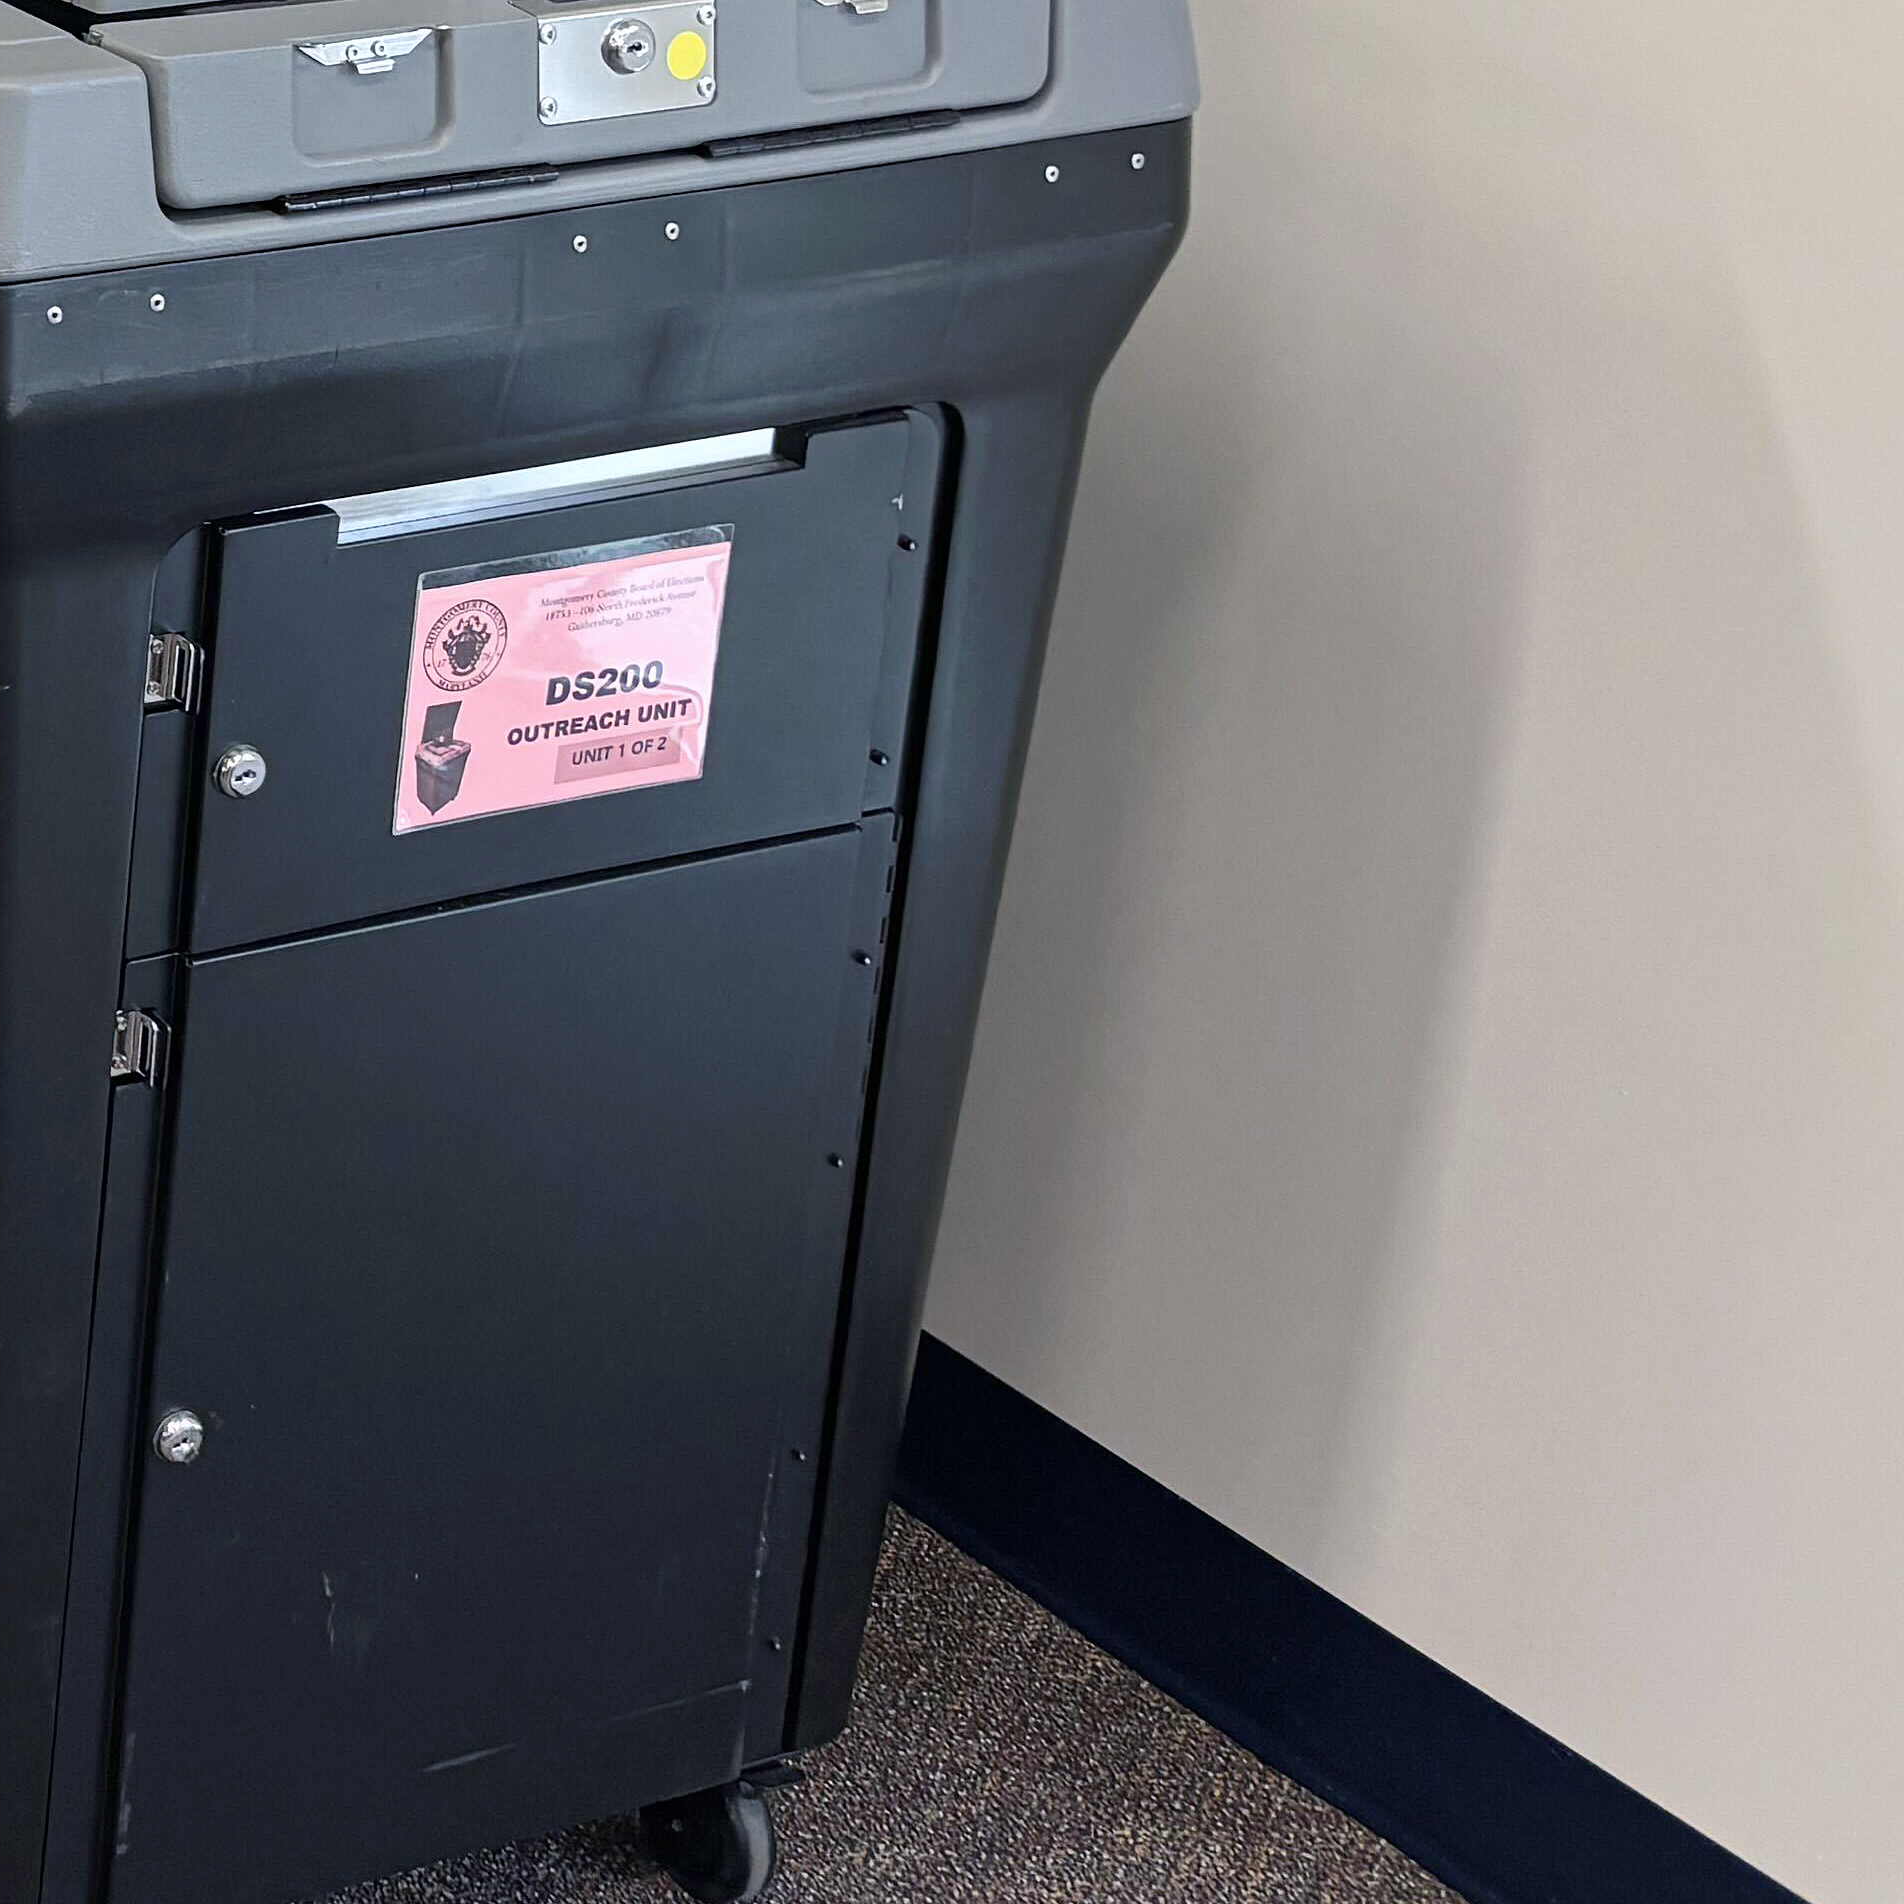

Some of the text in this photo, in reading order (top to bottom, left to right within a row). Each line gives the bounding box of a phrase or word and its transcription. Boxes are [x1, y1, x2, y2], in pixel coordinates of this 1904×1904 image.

[596, 586, 628, 599] County
[546, 660, 663, 705] DS200
[507, 698, 692, 746] OUTREACH UNIT
[572, 736, 667, 766] UNIT 1 OF 2
